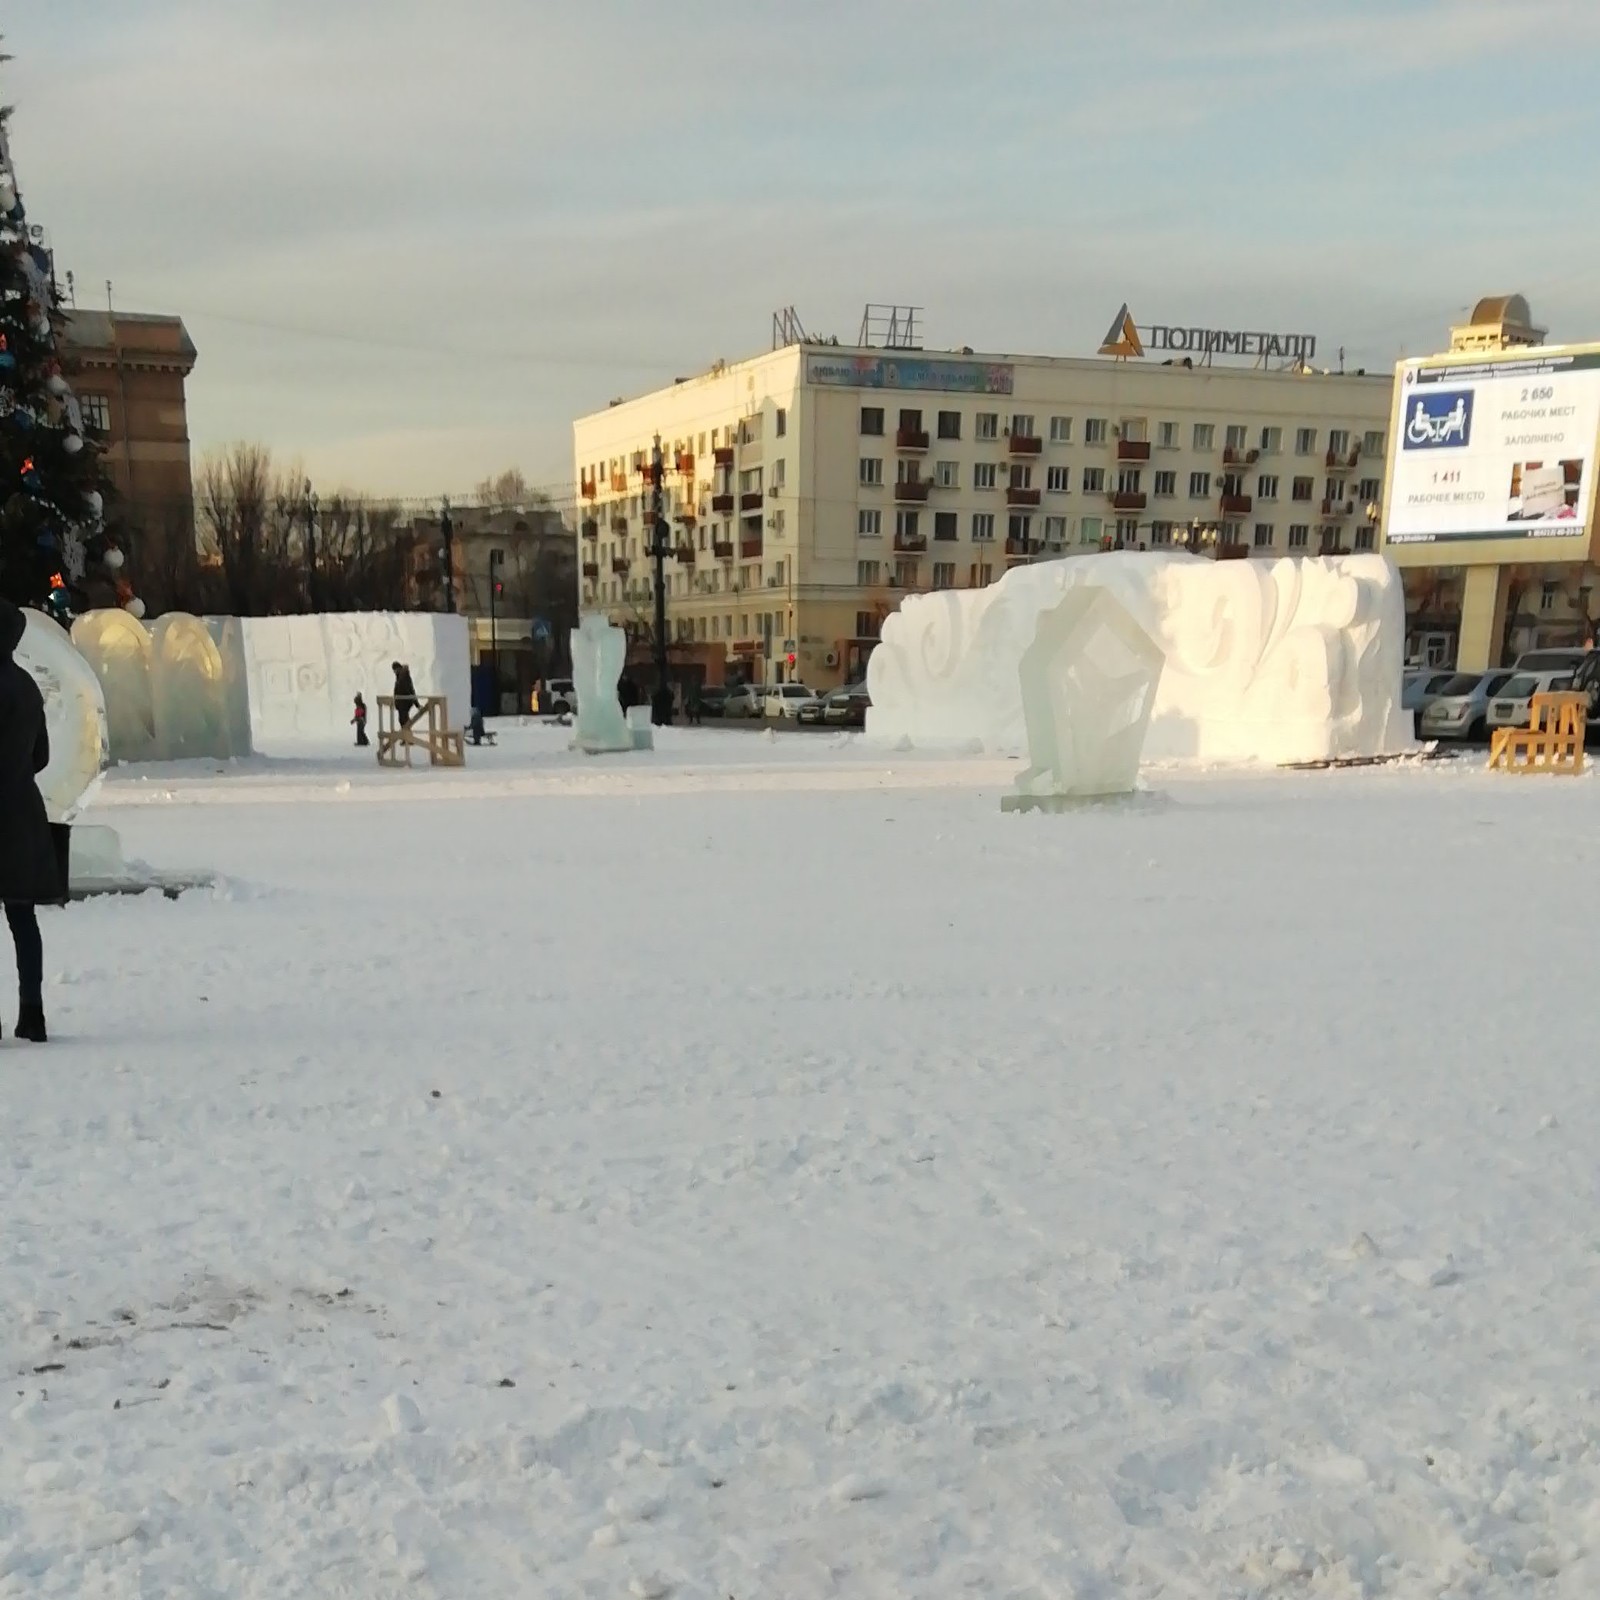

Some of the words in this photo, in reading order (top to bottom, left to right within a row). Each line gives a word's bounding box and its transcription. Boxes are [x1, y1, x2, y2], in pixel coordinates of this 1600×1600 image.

[1151, 325, 1316, 359] ПОЛИМЕТАЛЛ
[1521, 388, 1528, 402] 2
[1531, 386, 1554, 400] 650
[1501, 409, 1546, 420] РАБОЧИХ
[1550, 406, 1576, 418] МЕСТ
[1504, 433, 1565, 446] ЗАПОЛНЕНО
[1442, 470, 1462, 483] 411
[1408, 493, 1450, 504] РАБОЧЕЕ
[1453, 491, 1486, 502] МЕСТО
